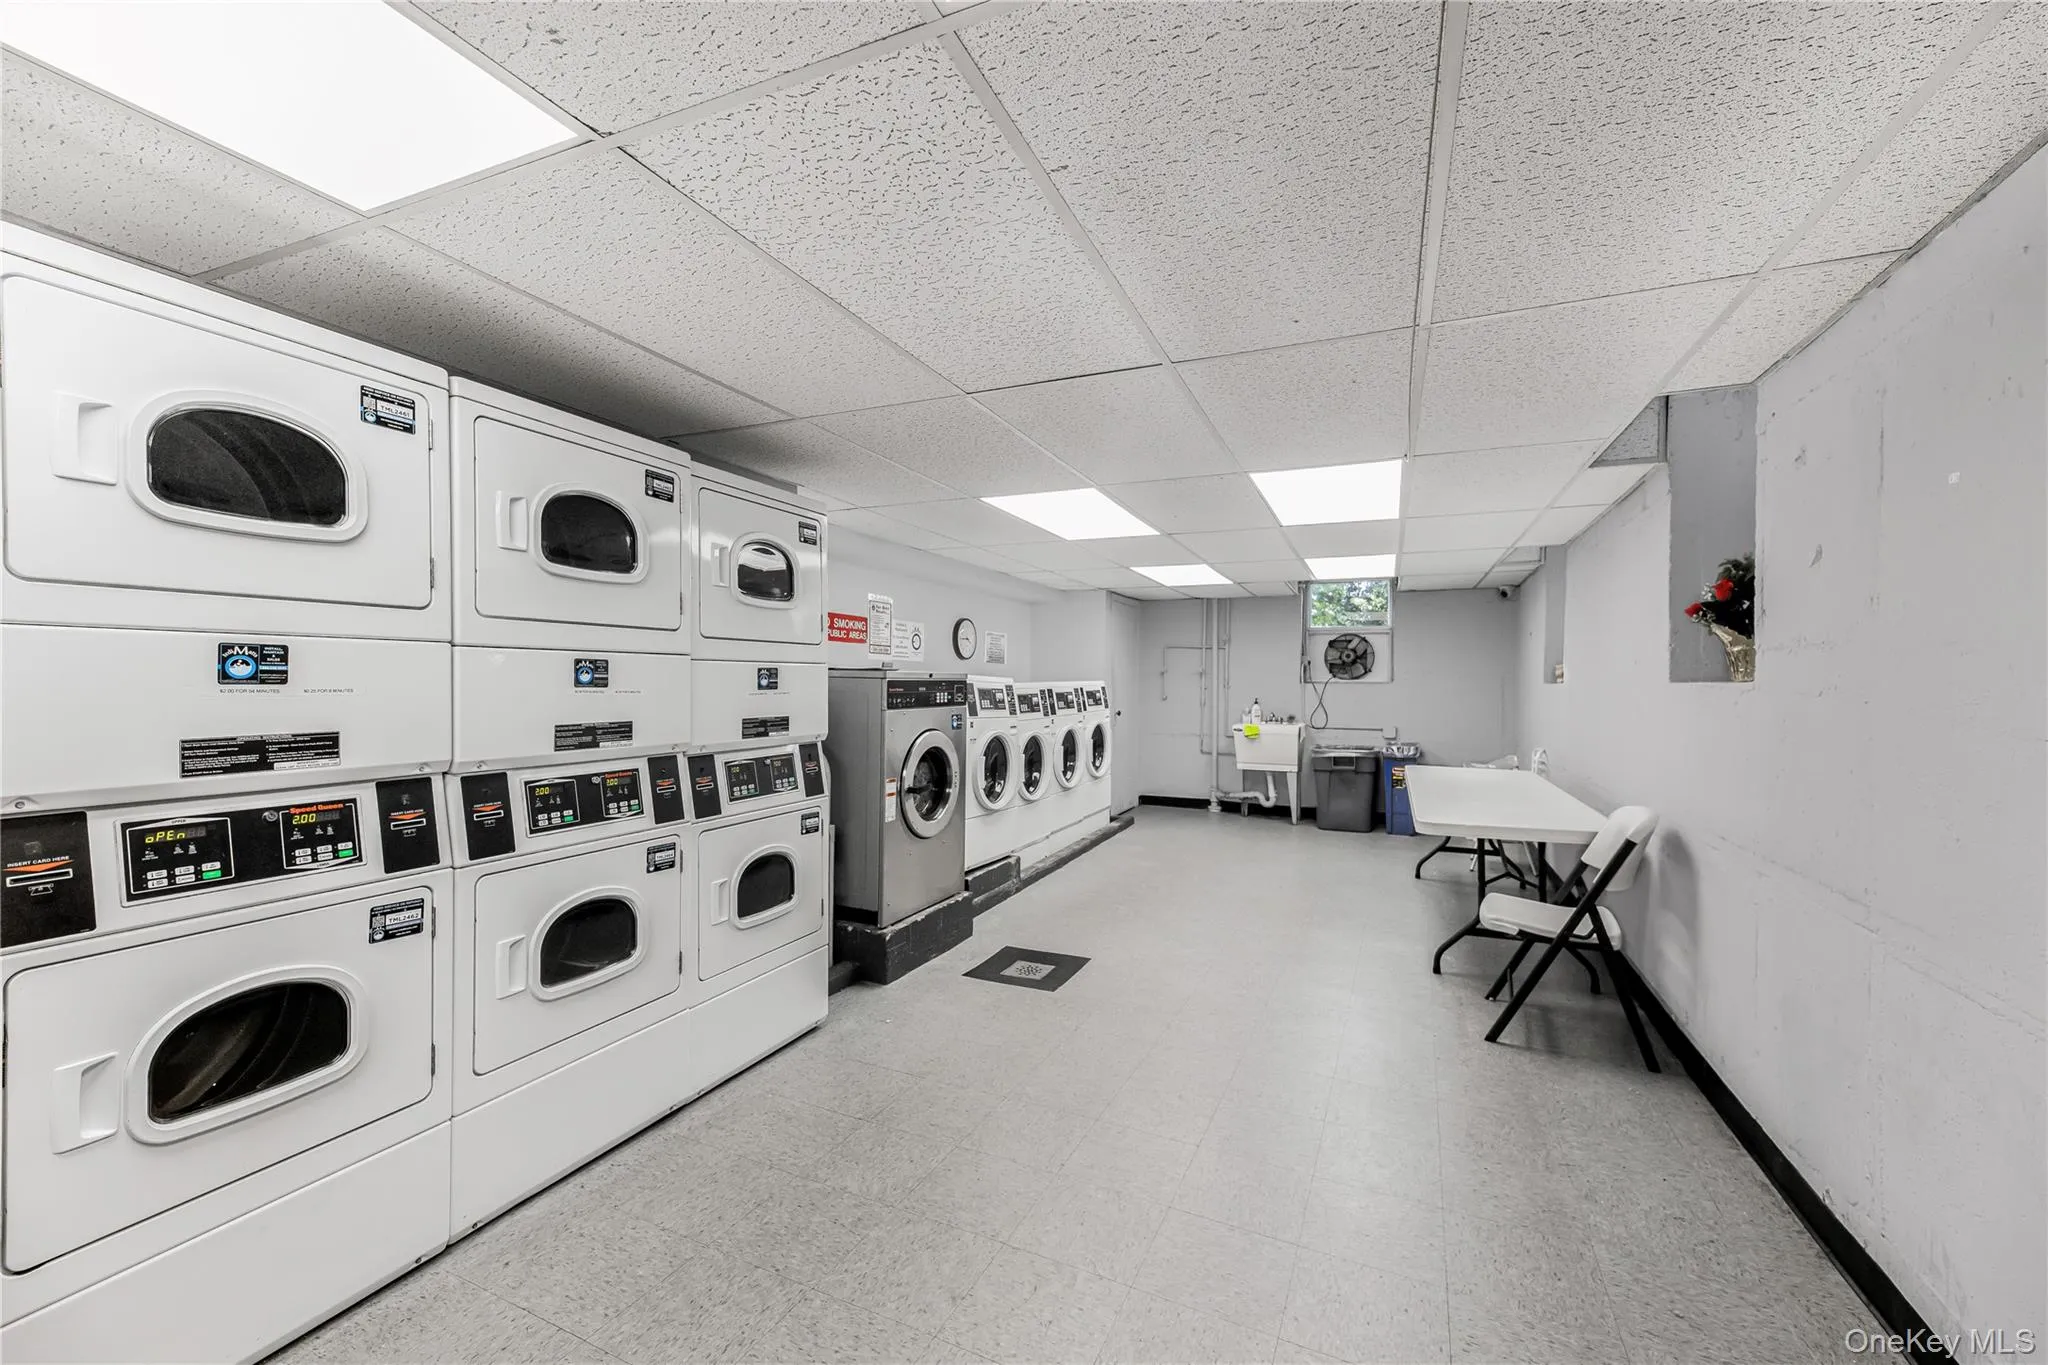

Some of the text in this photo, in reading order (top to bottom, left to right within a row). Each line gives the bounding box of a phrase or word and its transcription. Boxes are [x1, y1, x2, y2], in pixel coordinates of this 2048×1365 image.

[833, 617, 867, 631] SMOKING
[848, 631, 867, 640] AREAS
[289, 803, 344, 814] Speed Queen
[292, 813, 317, 825] 2.00
[6, 860, 32, 868] INSERT
